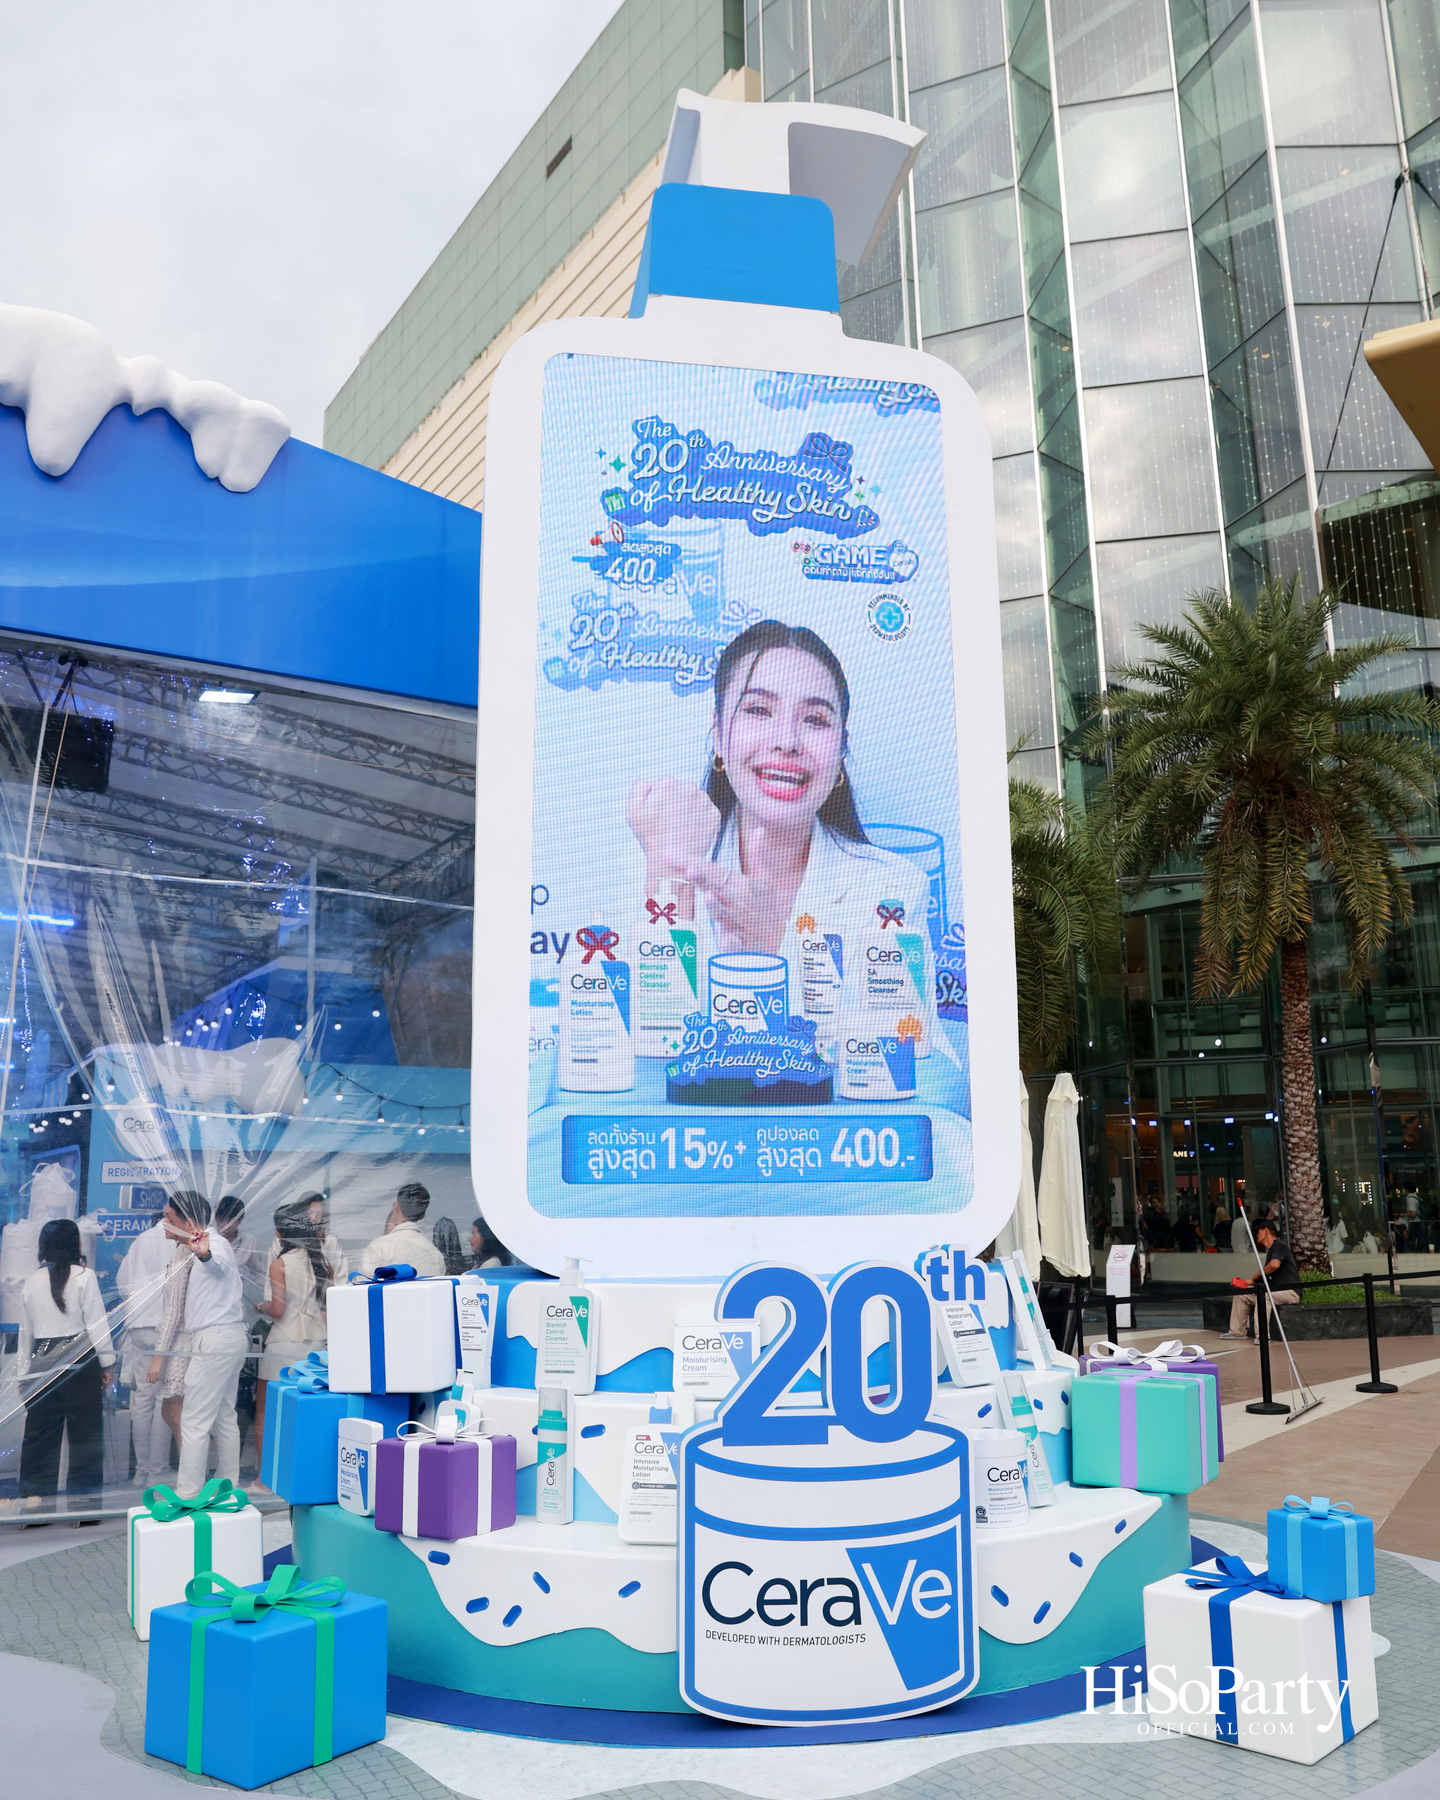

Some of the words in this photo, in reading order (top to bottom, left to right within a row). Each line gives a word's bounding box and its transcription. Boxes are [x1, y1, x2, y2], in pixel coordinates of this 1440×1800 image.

[637, 419, 671, 437] The
[634, 435, 706, 480] 20th
[700, 444, 849, 492] Anniversary
[630, 481, 672, 512] of
[668, 475, 793, 523] Healthy
[785, 482, 851, 520] Skin
[815, 544, 888, 566] GAME
[868, 593, 904, 609] RECOMMENDED
[902, 602, 910, 611] BY
[869, 624, 910, 641] DERMATOLOGISTS
[601, 641, 713, 685] Healthy
[530, 931, 570, 963] ay
[639, 941, 695, 957] CeraVe
[802, 939, 840, 952] CeraVe
[867, 946, 920, 963] CeraVe
[868, 968, 877, 976] SA
[571, 974, 627, 990] CeraVe
[868, 977, 904, 986] Smoothing
[713, 994, 783, 1015] CeraVe
[686, 1014, 707, 1027] The
[684, 1022, 728, 1055] 20th
[724, 1028, 813, 1055] Anniversary
[846, 1038, 897, 1054] CeraVe
[683, 1055, 708, 1076] of
[705, 1050, 780, 1078] Healthy
[776, 1049, 815, 1072] Skin
[587, 1124, 656, 1145] ลดทั้งร้าน
[757, 1125, 819, 1146] คูปองลด
[587, 1147, 656, 1179] สูงสุด
[757, 1144, 822, 1176] สูงสุด
[105, 1219, 153, 1231] CERAM
[461, 1297, 488, 1306] CeraVe
[546, 1305, 588, 1318] CeraVe
[682, 1334, 744, 1350] CeraVe
[683, 1356, 727, 1364] Moisturising
[341, 1447, 366, 1468] CeraVe
[546, 1448, 554, 1485] CeraVe
[702, 1559, 953, 1627] CeraVe
[705, 1629, 756, 1644] DEVELOPED
[757, 1636, 780, 1646] WITH
[783, 1633, 866, 1646] DERMATOLOGISTS
